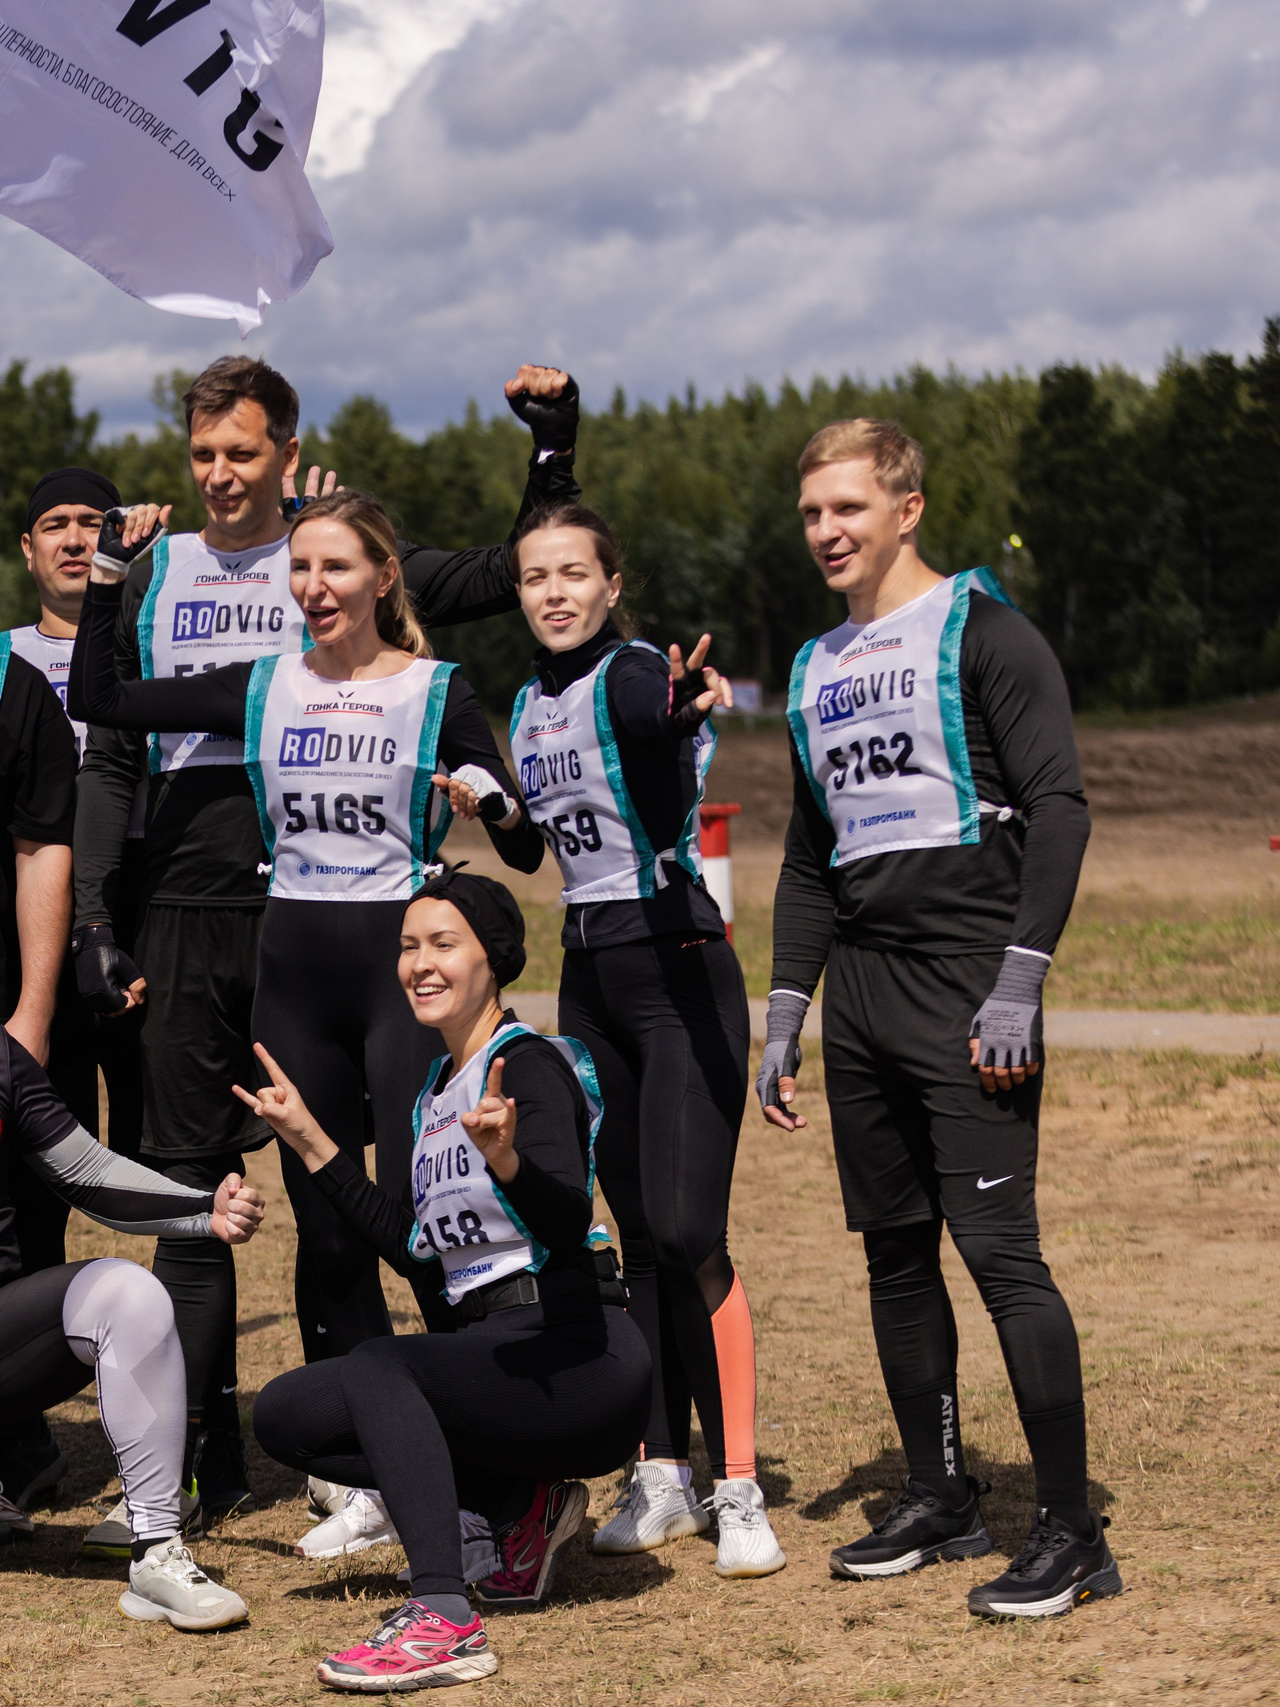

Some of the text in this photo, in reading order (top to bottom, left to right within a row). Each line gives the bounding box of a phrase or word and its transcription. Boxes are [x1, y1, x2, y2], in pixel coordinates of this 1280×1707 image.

[62, 62, 178, 148] БЛАГОСОСТОЯНИЕ
[169, 139, 207, 172] ДЛЯ
[201, 166, 237, 202] ВСЕХ
[195, 572, 270, 583] ГОНКА ГЕРОЕВ
[175, 603, 285, 637] RODVIG
[865, 637, 902, 651] ГЕРОЕВ
[306, 702, 383, 713] ГОНКА ГЕРОЕВ
[819, 668, 916, 719] RODVIG
[282, 732, 397, 765] RODVIG
[826, 732, 923, 791] 5162
[522, 749, 582, 794] RODVIG
[282, 792, 387, 836] 5165
[859, 809, 916, 828] ГАЗПРОМБАНК
[316, 865, 377, 876] ГАЗПРОМБАНК
[417, 1209, 491, 1253] 158
[940, 1393, 956, 1478] ATHLEX
